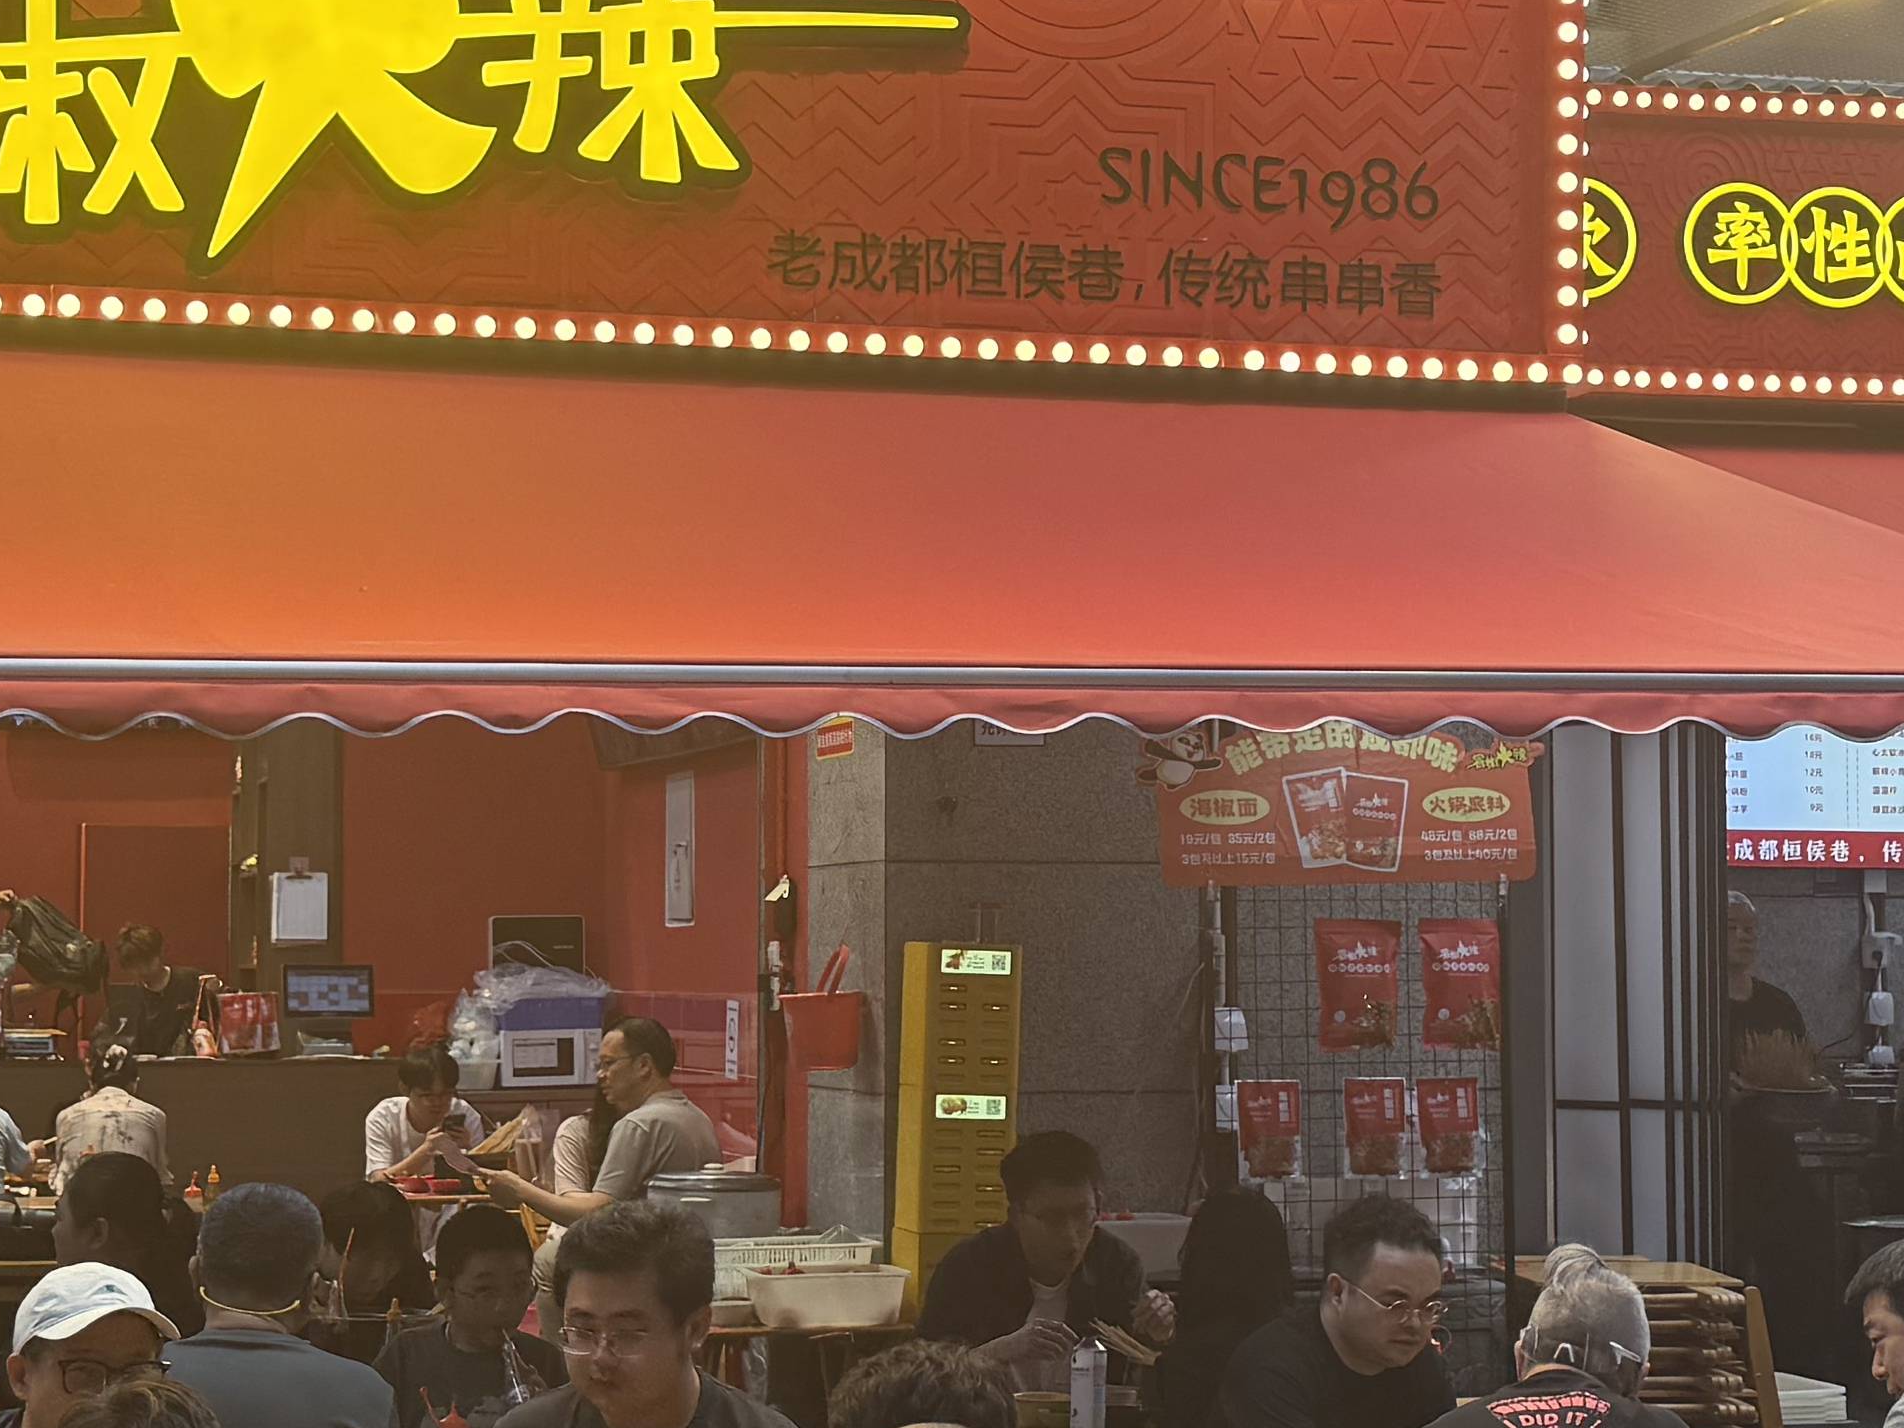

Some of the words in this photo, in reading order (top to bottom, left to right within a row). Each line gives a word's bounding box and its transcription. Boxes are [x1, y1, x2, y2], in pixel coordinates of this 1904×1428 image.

[1190, 798, 1258, 818] 海椒面
[1429, 795, 1507, 813] 火锅底料
[1519, 1413, 1558, 1427] DID
